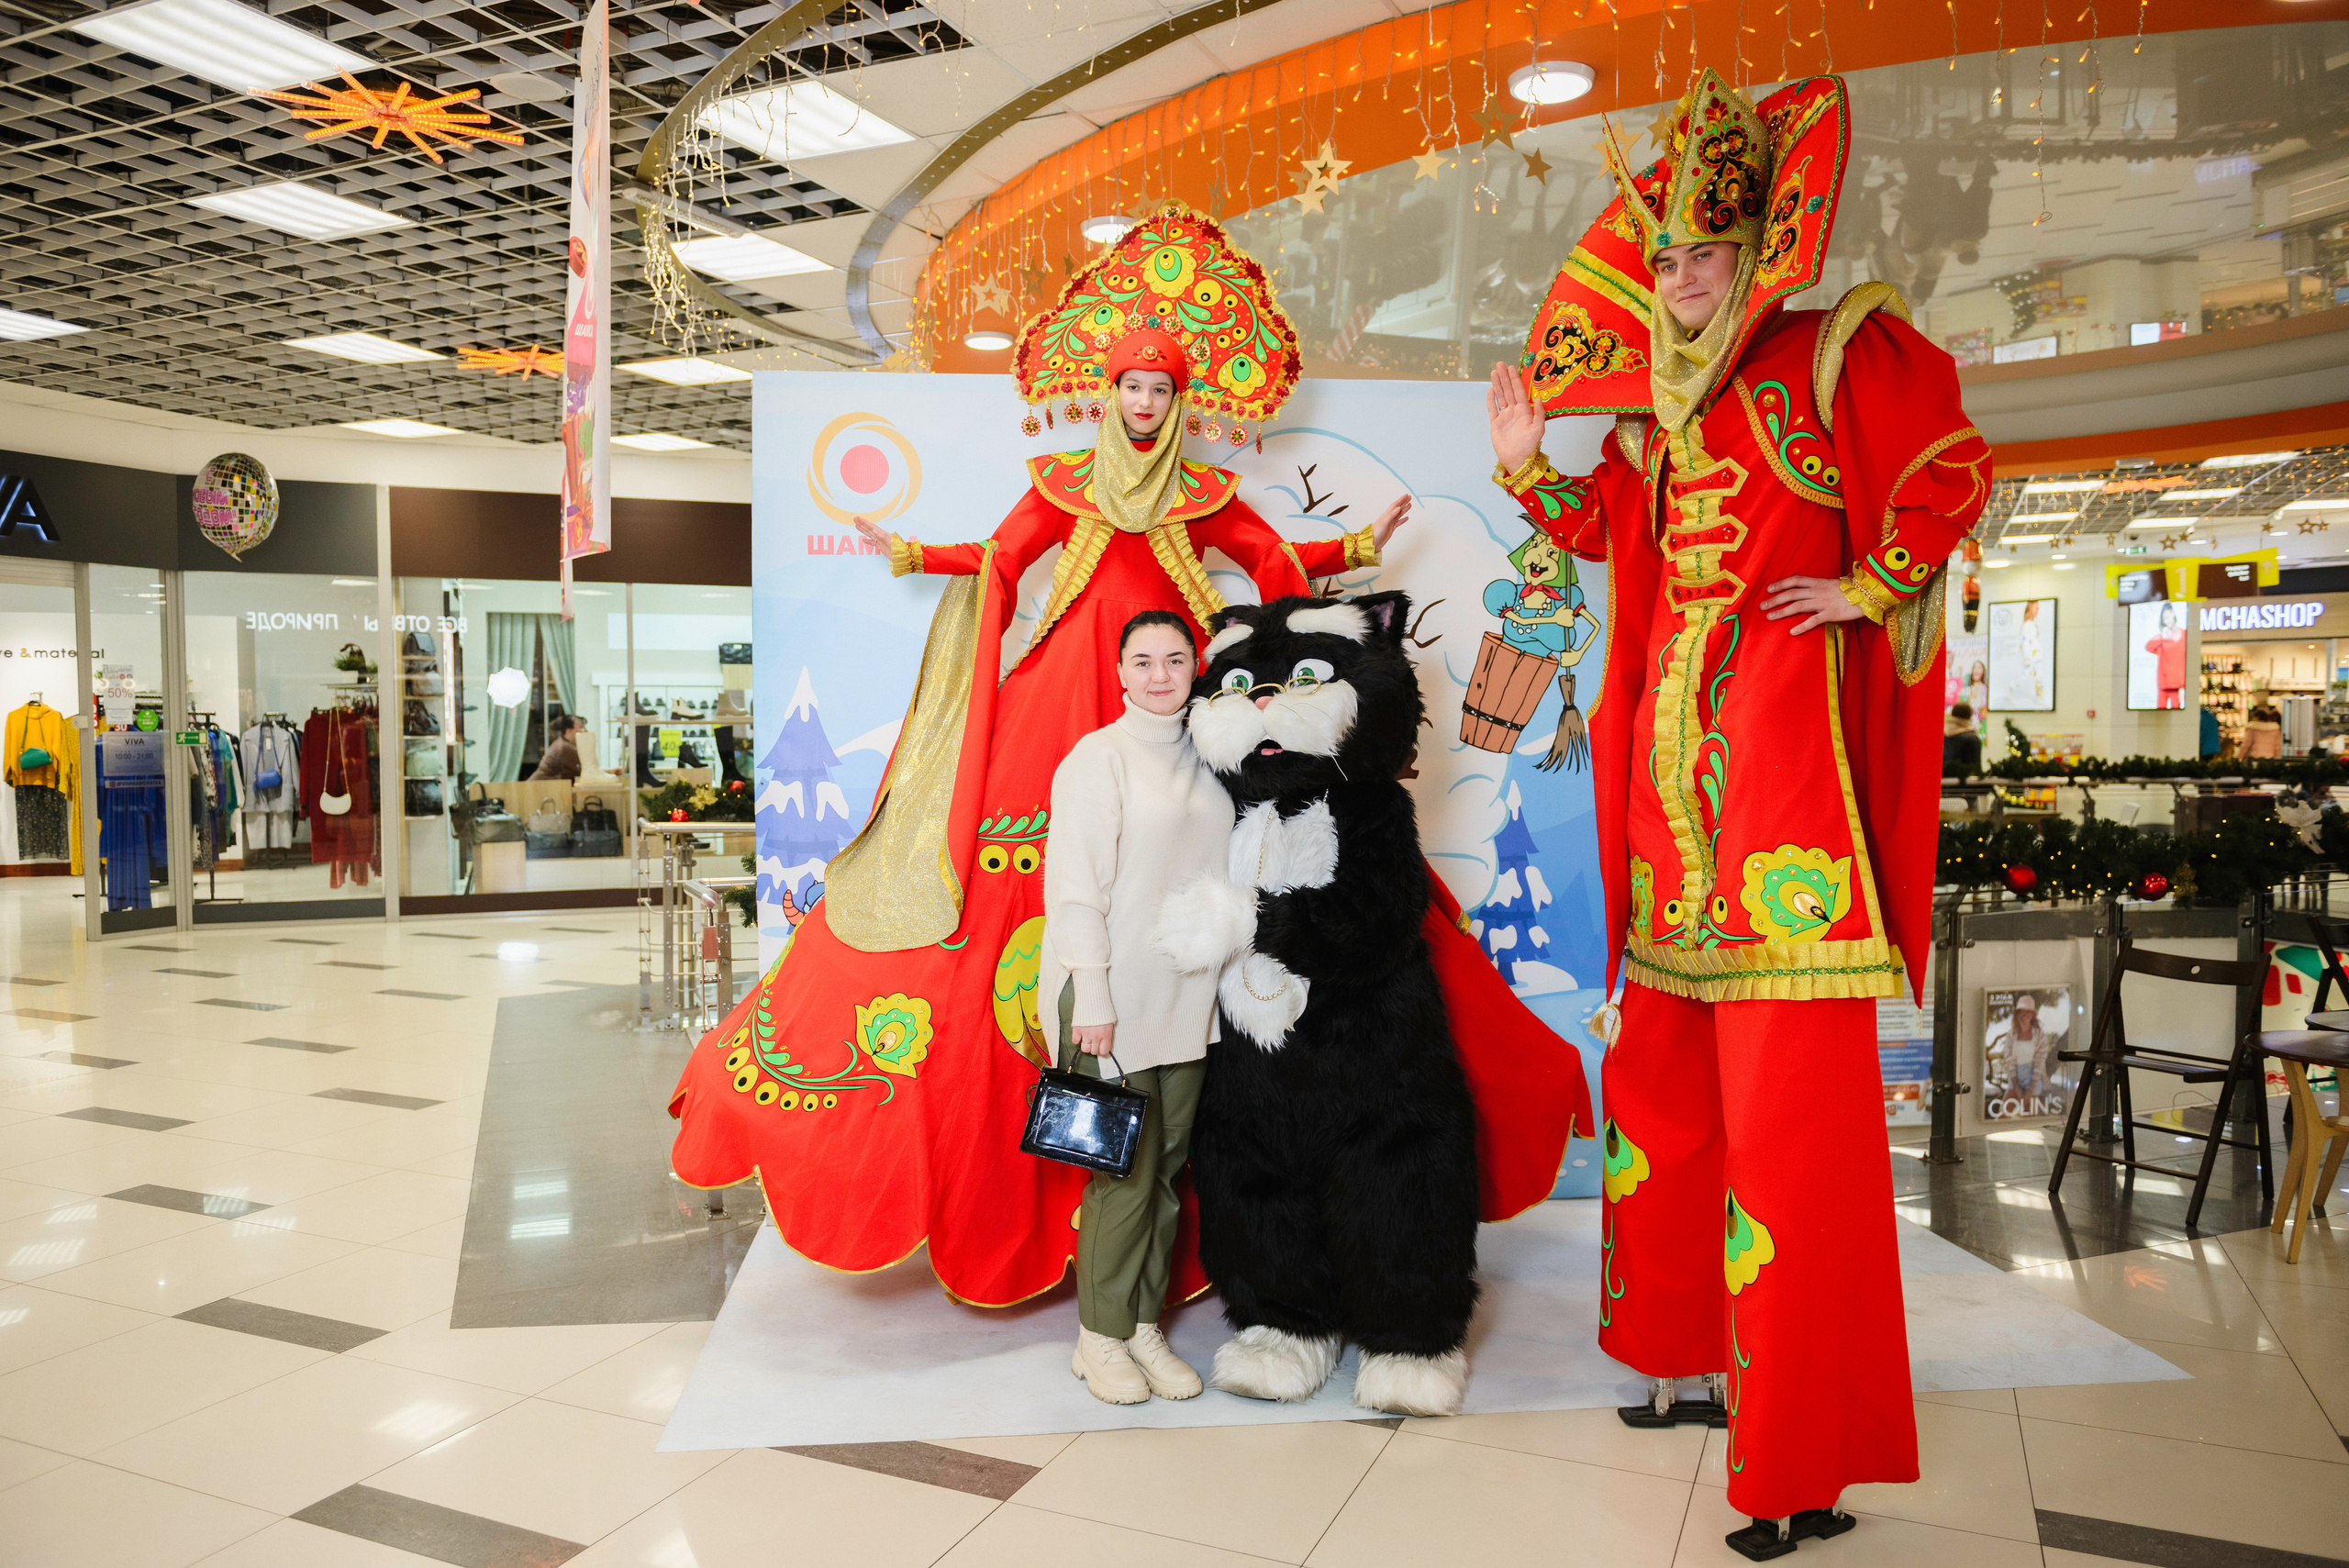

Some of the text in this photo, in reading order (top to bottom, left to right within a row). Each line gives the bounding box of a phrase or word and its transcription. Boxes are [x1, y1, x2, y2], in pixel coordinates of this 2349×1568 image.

[193, 488, 229, 506] ОВЫМ
[807, 534, 918, 556] ШАМ
[2199, 602, 2325, 631] MCHASHOP
[20, 647, 31, 658] &
[34, 648, 105, 660] mateal
[107, 687, 133, 698] 50%
[124, 738, 145, 746] VIVA
[115, 752, 131, 761] 10:00
[1987, 1092, 2064, 1119] COLIN'S
